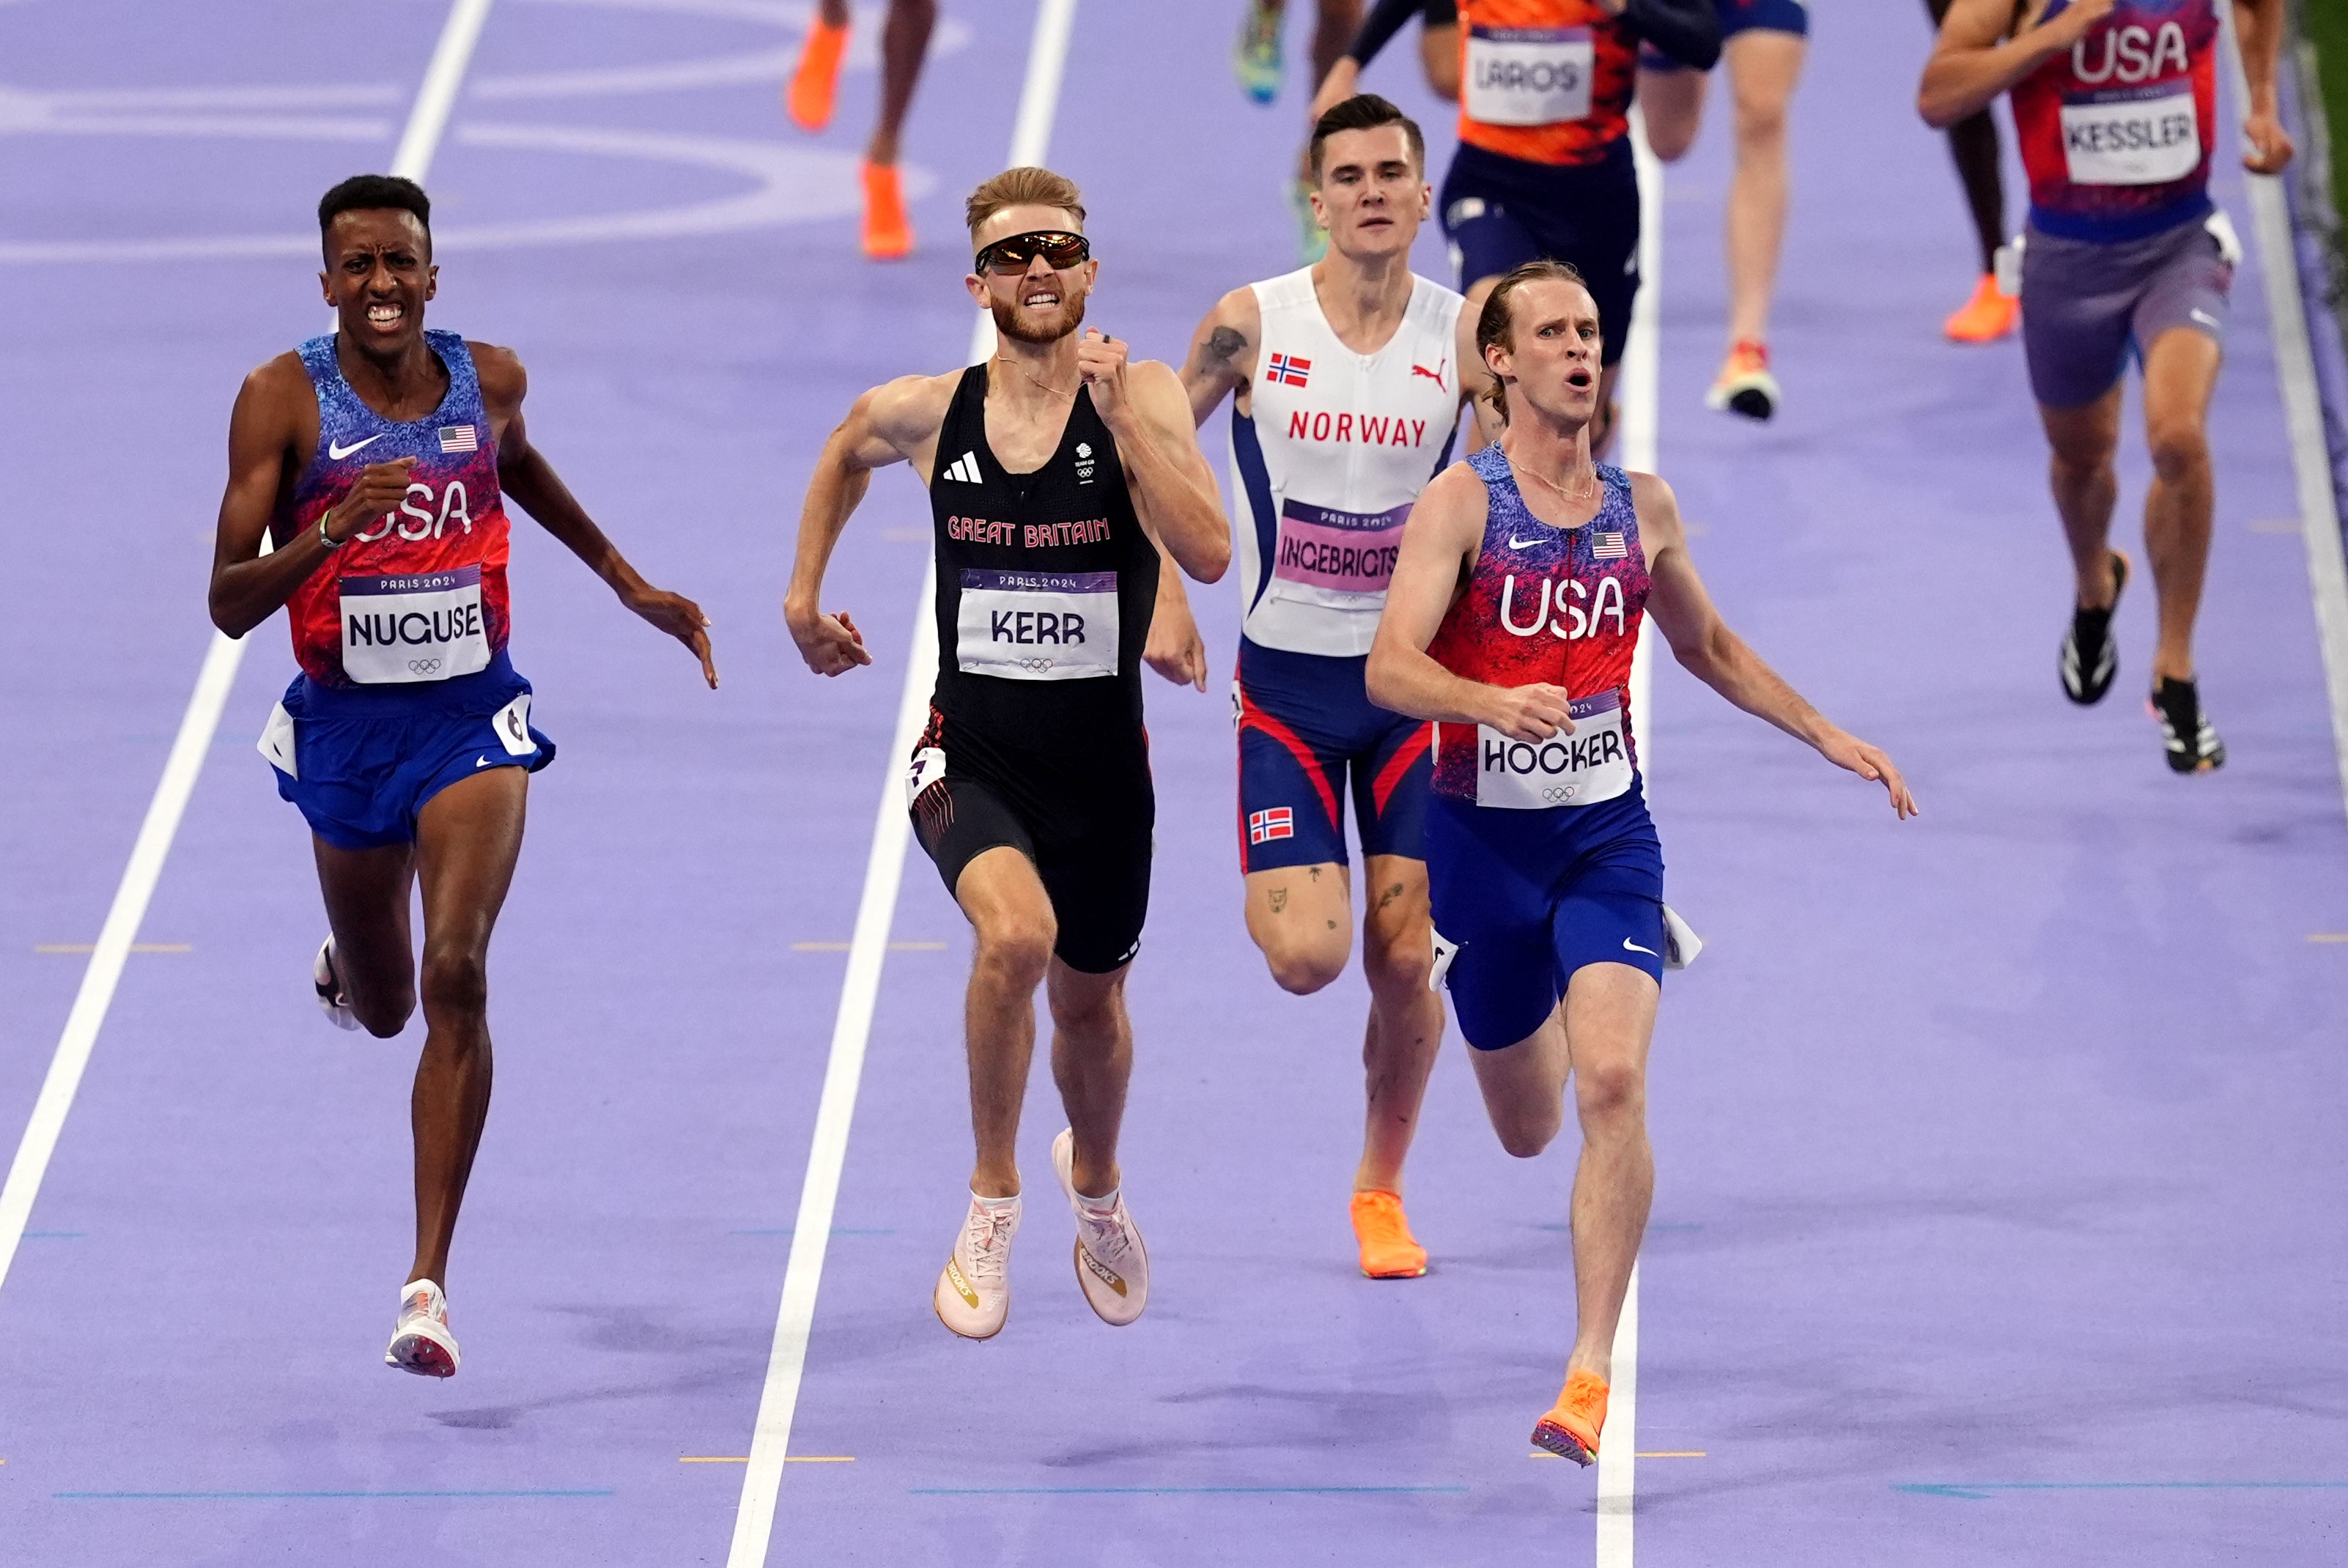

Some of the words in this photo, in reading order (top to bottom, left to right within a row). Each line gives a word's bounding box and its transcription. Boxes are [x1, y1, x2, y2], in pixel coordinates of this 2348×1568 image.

[2072, 21, 2189, 84] USA
[2067, 114, 2190, 152] KESSLER
[1289, 411, 1425, 448] NORWAY
[948, 515, 1016, 546] GREAT
[1025, 517, 1111, 548] BRITAIN
[1321, 511, 1358, 526] PARIS
[381, 578, 419, 589] PARIS
[424, 574, 455, 588] 2024
[1000, 576, 1038, 587] PARIS
[1041, 577, 1077, 588] 2024
[349, 603, 481, 646] NUGUSE
[1500, 574, 1625, 640] USA
[992, 610, 1085, 644] KERR
[1570, 703, 1592, 714] 024
[1484, 733, 1624, 774] HOCKER
